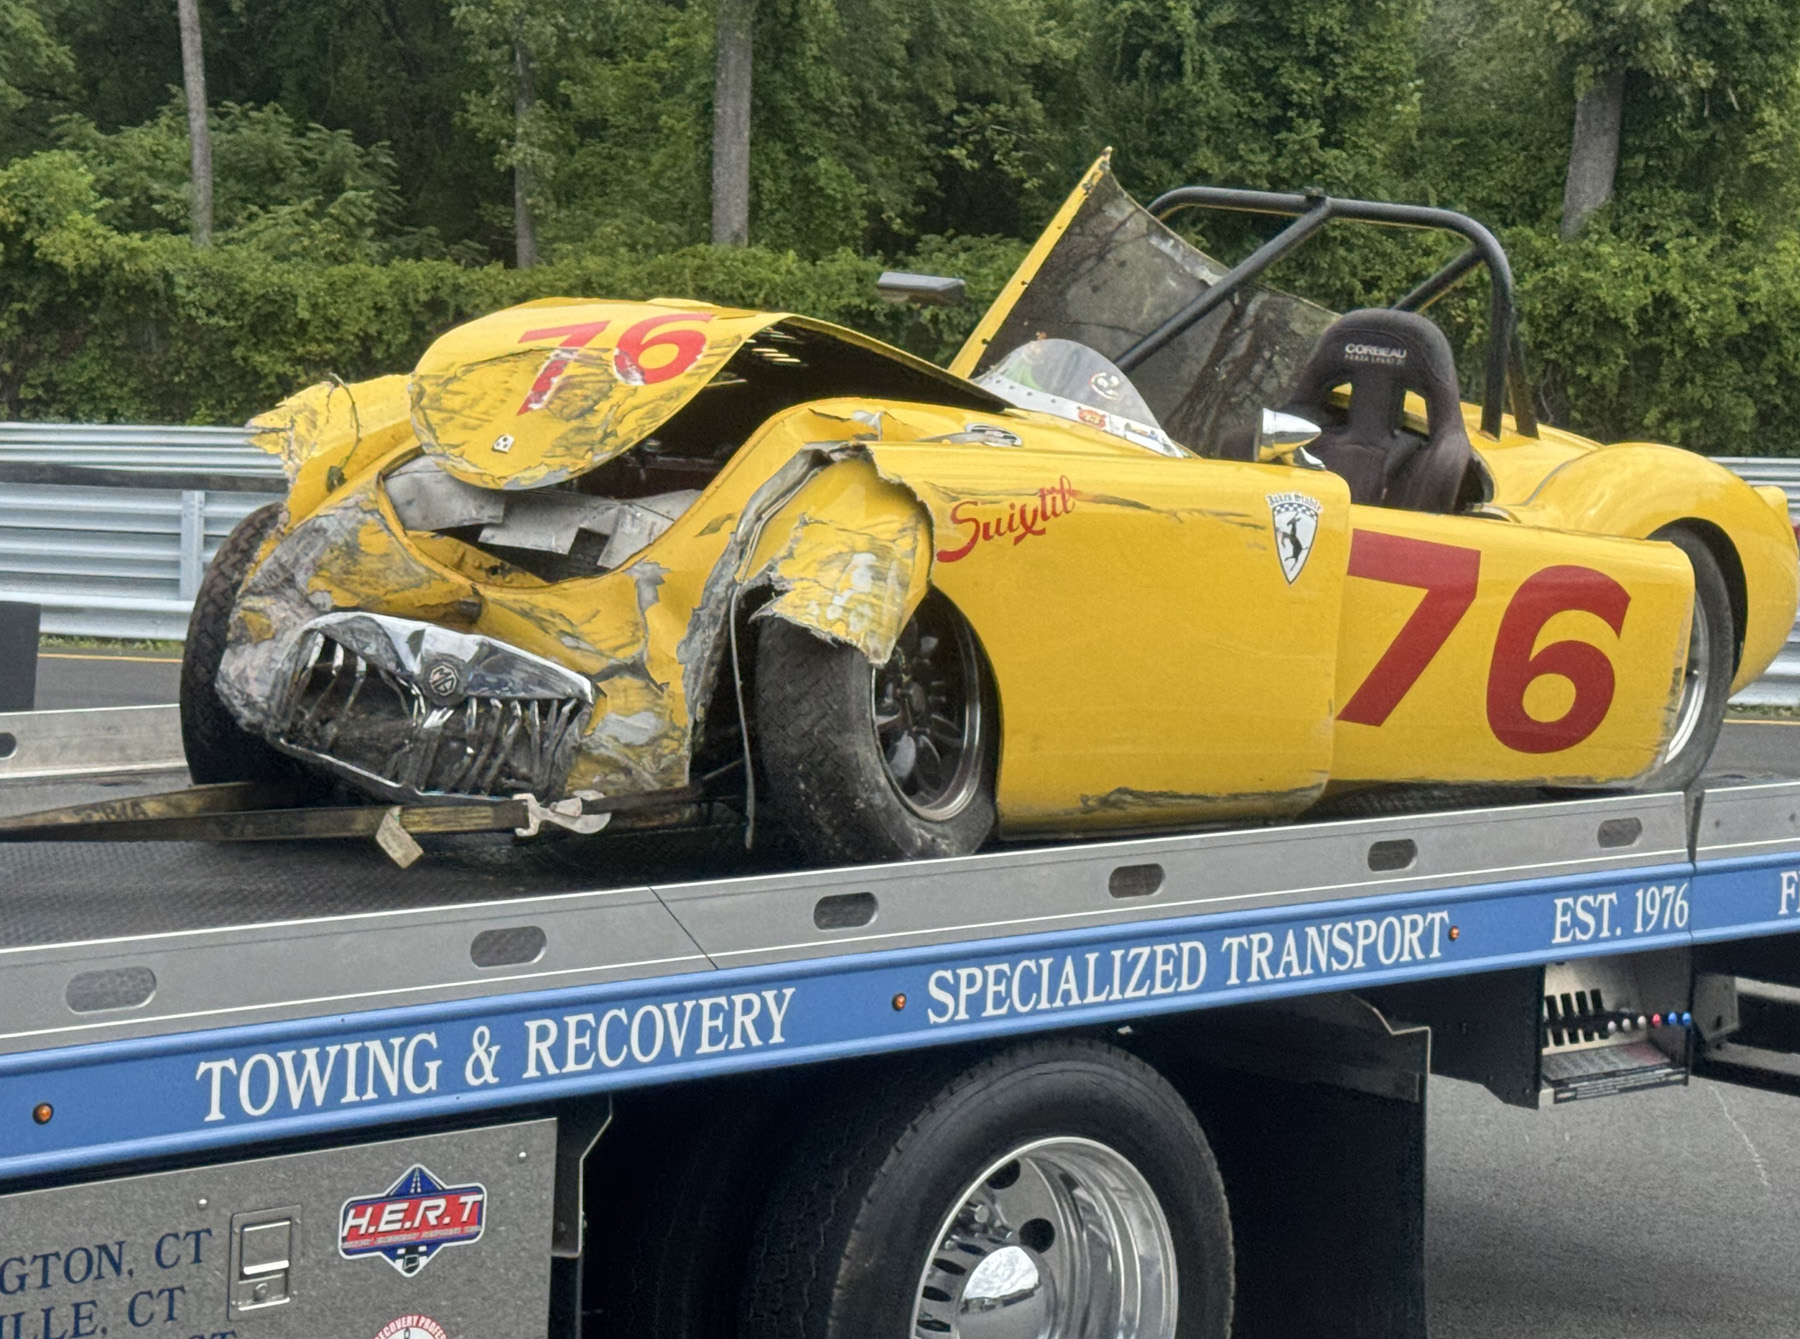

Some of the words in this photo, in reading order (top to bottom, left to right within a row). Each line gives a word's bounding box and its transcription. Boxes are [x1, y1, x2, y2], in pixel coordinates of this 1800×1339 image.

[517, 313, 714, 416] 76
[1335, 528, 1631, 754] 76
[195, 1032, 443, 1122] TOWING
[465, 1025, 501, 1086] &
[522, 987, 796, 1079] RECOVERY
[928, 940, 1208, 1024] SPECIALIZED
[1221, 911, 1450, 985] TRANSPORT
[1552, 892, 1622, 944] EST.
[1633, 883, 1689, 934] 1976
[1778, 870, 1800, 915] F
[341, 1194, 484, 1238] H.E.R.T
[155, 1228, 213, 1270] CT
[128, 1285, 187, 1328] CT
[374, 1315, 419, 1339] ECOVERY
